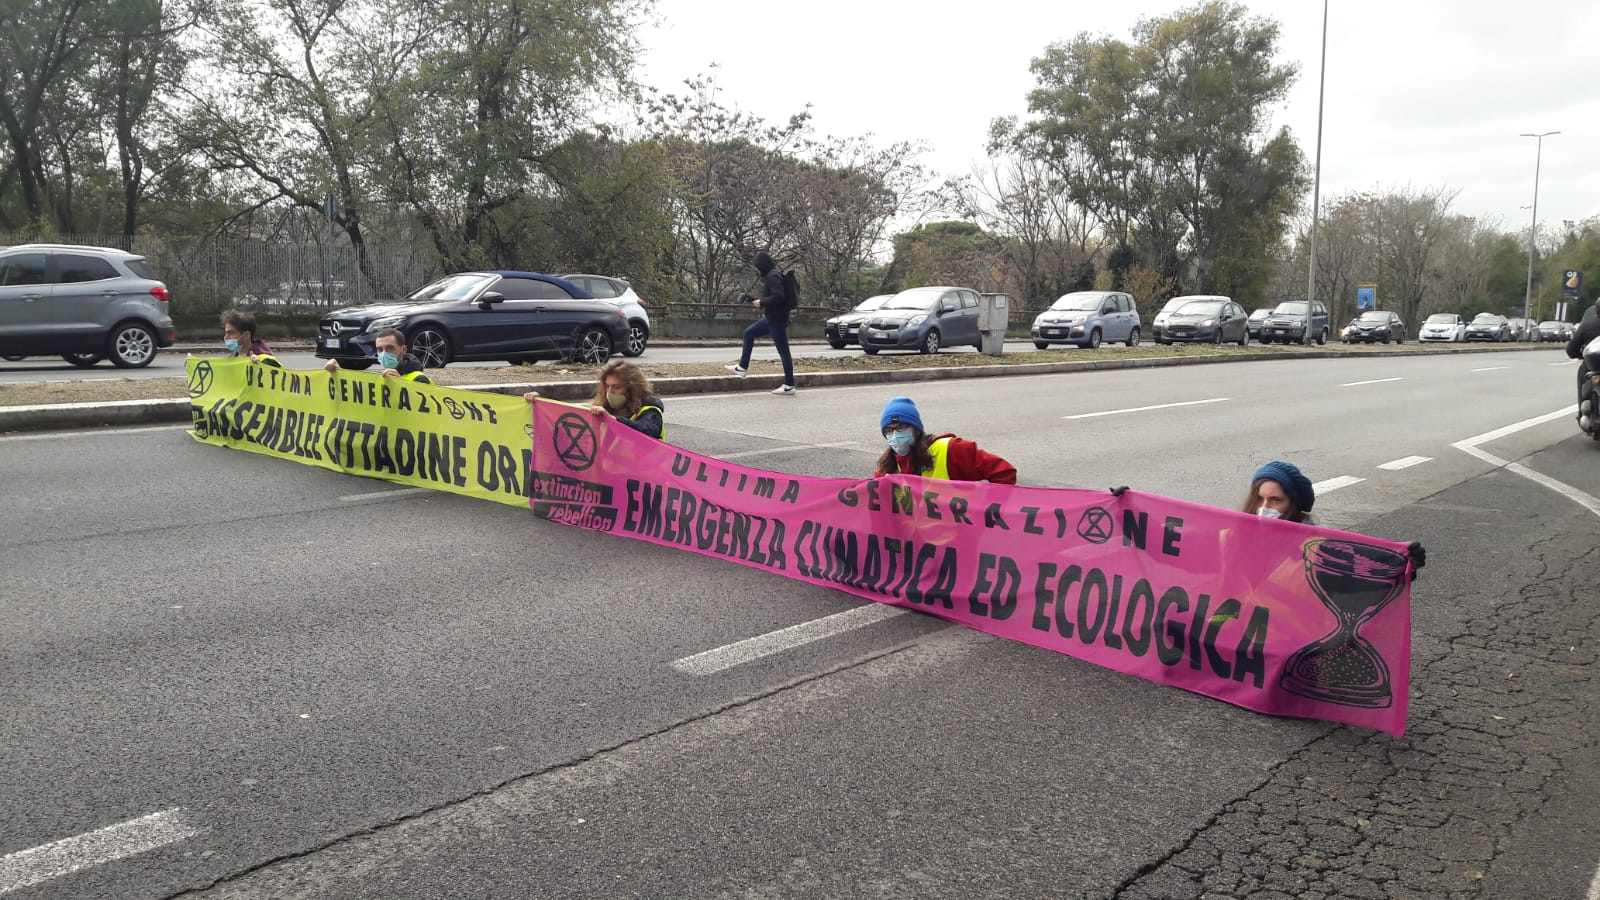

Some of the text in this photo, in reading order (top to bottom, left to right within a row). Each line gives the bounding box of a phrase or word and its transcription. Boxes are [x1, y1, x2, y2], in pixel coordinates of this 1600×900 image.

[245, 365, 498, 424] ULTIMA GENERAZIONE
[208, 398, 323, 461] ASSEMBLEE
[324, 417, 467, 488] CITTADINE
[533, 476, 600, 504] extinction
[547, 503, 612, 531] rebellion
[672, 452, 1184, 557] ULTIMA GENERAZIONE
[623, 479, 1271, 689] EMERGENZA CLIMATICA ED ECOLOGICA
